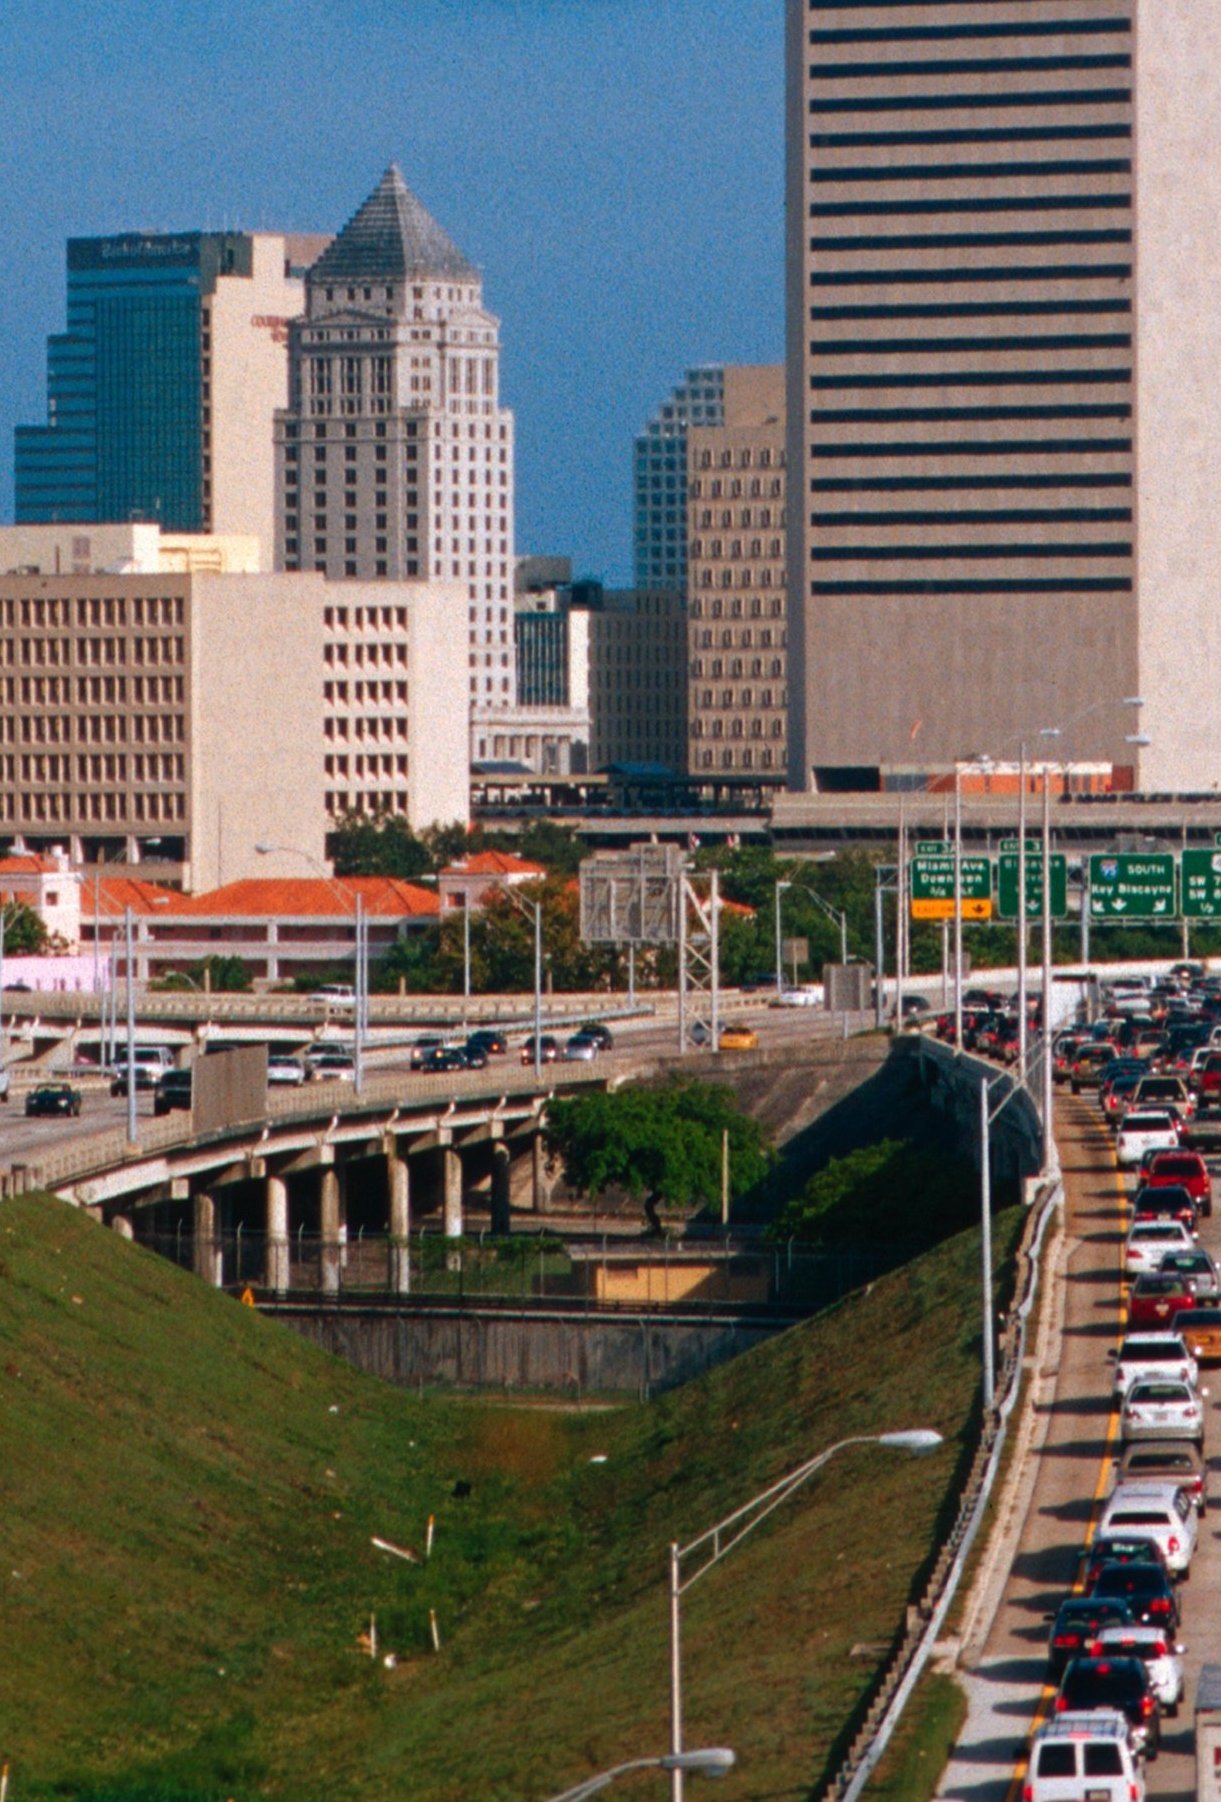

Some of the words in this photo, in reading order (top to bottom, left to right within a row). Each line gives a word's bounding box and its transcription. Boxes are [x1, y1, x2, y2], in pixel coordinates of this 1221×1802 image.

[916, 861, 955, 871] Miami
[1127, 864, 1165, 875] SOUTH
[920, 873, 983, 884] Downown
[1189, 876, 1206, 886] SW
[1091, 883, 1114, 896] Key
[1118, 883, 1172, 896] Biscayne
[1189, 888, 1206, 899] SW
